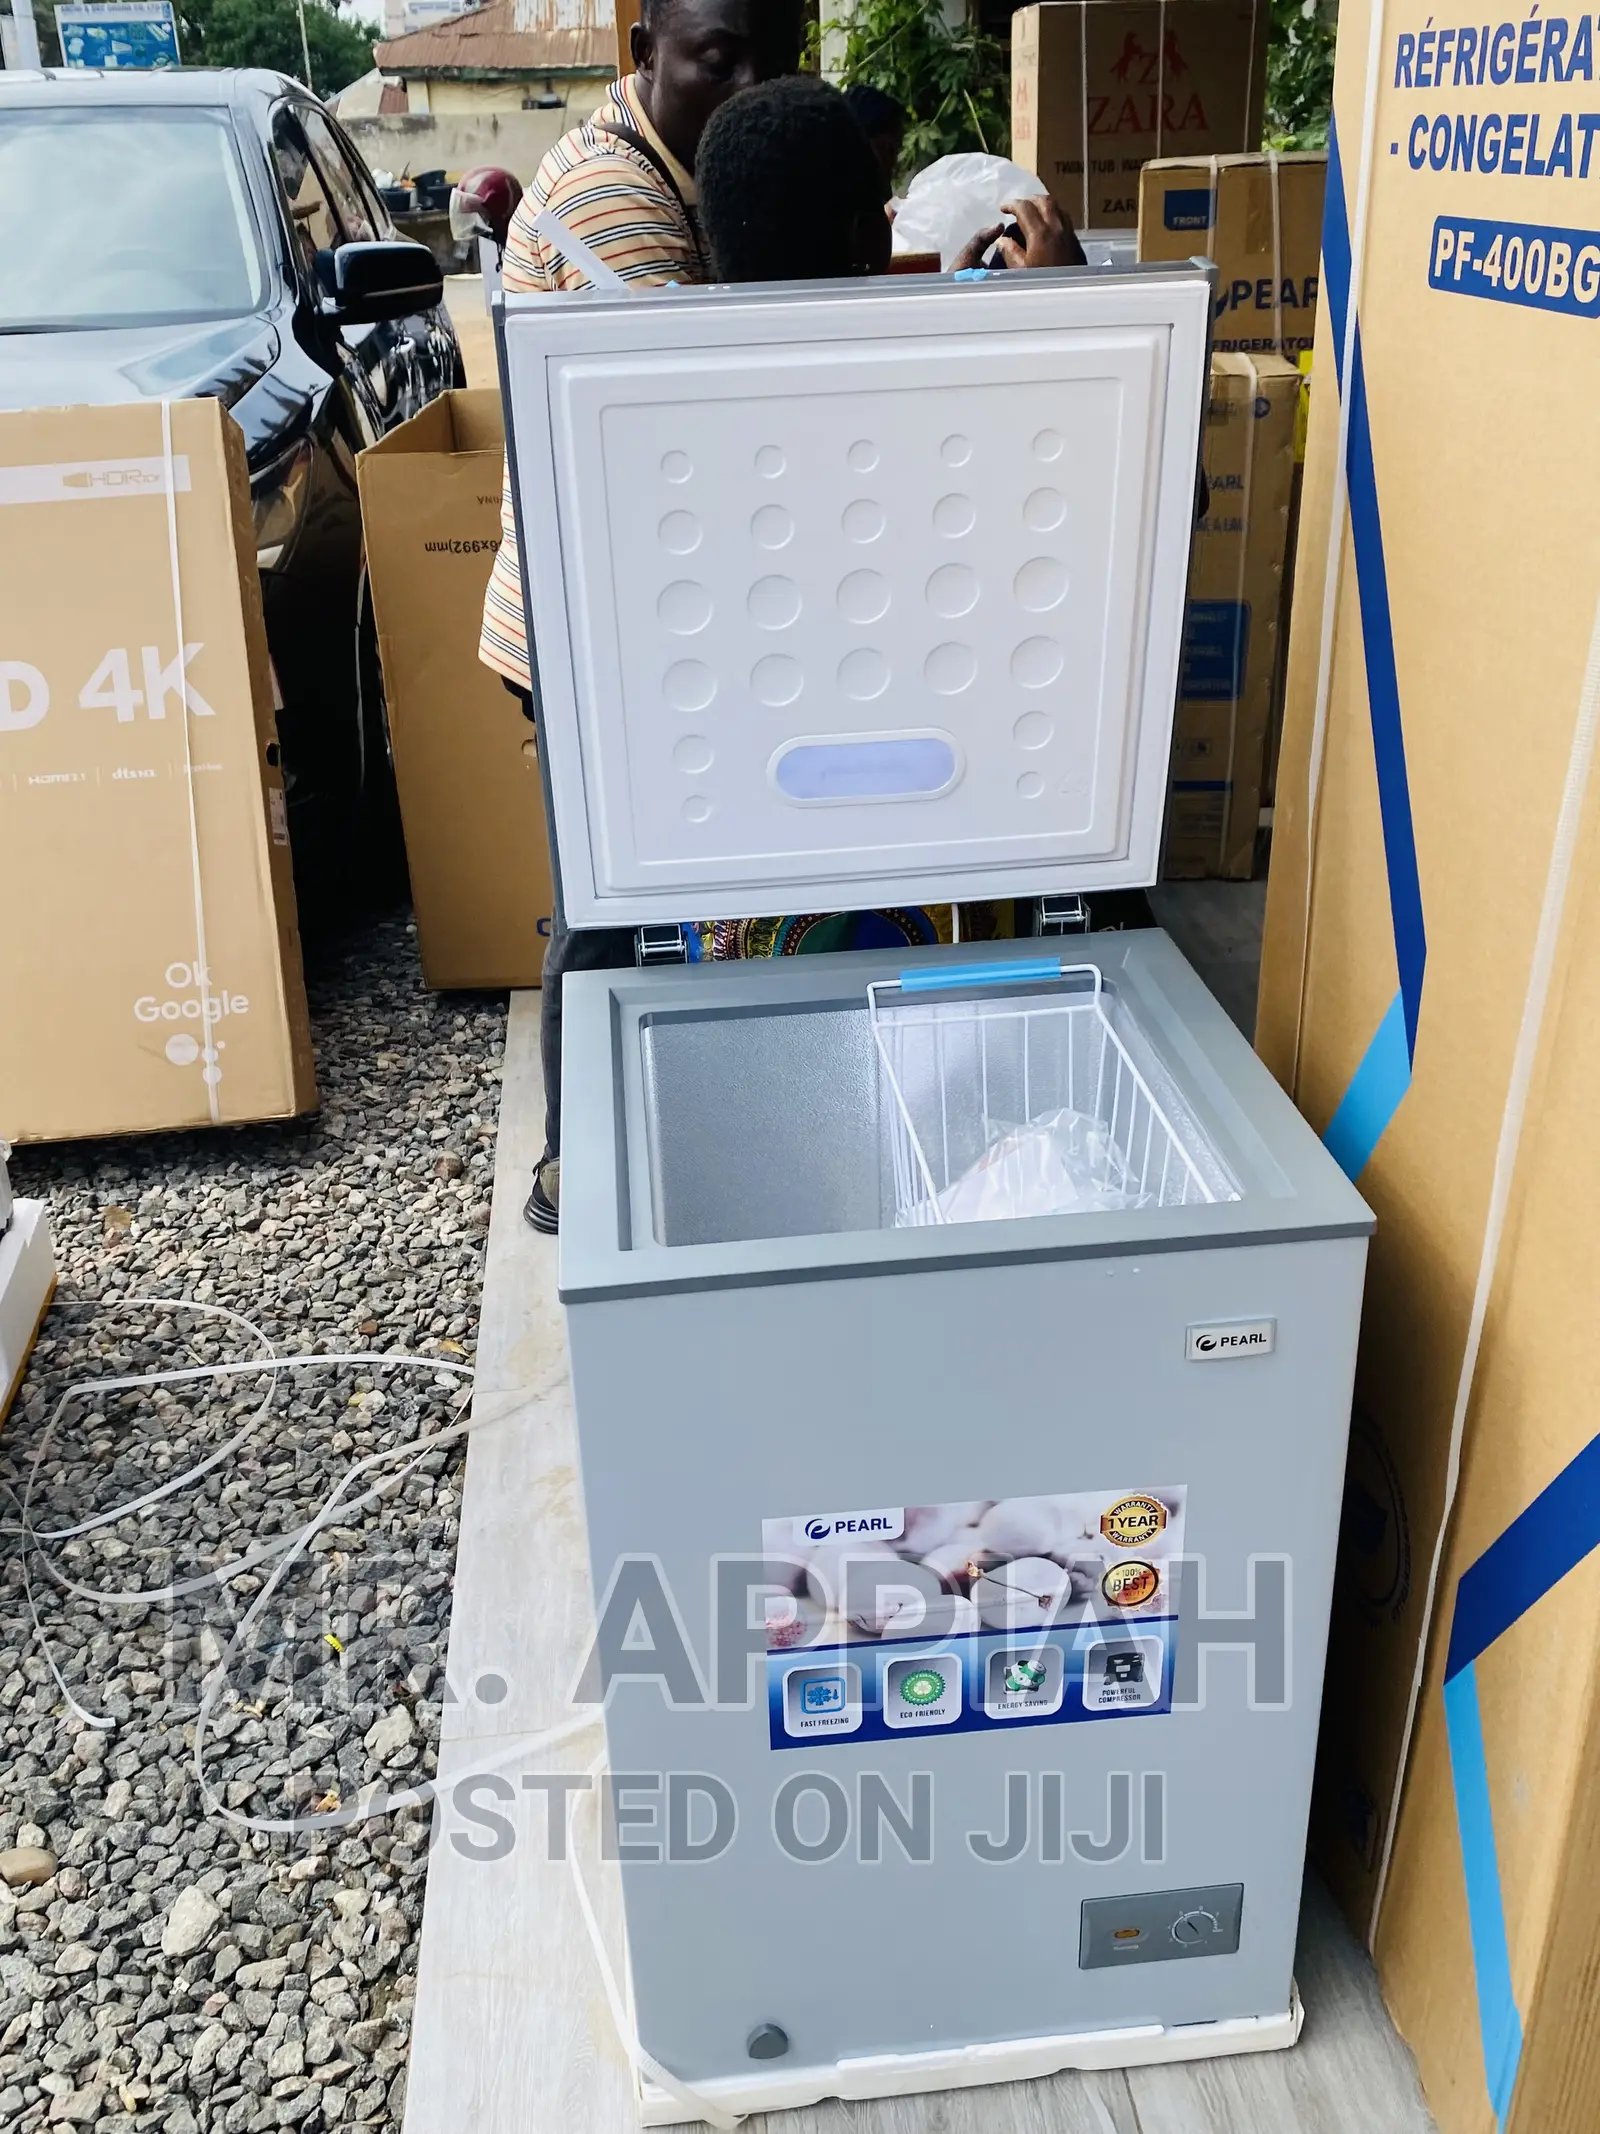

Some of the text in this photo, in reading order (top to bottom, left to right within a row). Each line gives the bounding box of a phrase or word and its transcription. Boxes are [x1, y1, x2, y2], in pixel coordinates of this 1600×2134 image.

[1394, 4, 1600, 88] RÉFRIGÉRA
[1089, 92, 1210, 135] ZARA
[1408, 113, 1600, 179] CONGELAT
[1091, 157, 1115, 173] TUB
[1172, 215, 1208, 226] FRONT
[425, 538, 502, 554] 6x992)mm
[78, 642, 217, 723] 4K
[134, 990, 250, 1024] Google
[1220, 1333, 1267, 1347] PEARL
[1113, 1501, 1156, 1516] WARRANTY
[835, 1517, 893, 1533] PEARL
[1107, 1514, 1160, 1530] 1 YEAR
[1112, 1528, 1154, 1544] WARRANTY
[1112, 1575, 1150, 1592] BEST
[1098, 1693, 1142, 1704] COMPRESSOR
[1102, 1687, 1136, 1696] POWERFUL
[997, 1699, 1048, 1710] ENERGY SAVING
[800, 1717, 850, 1728] FAST FREEZING
[900, 1711, 913, 1719] ECO
